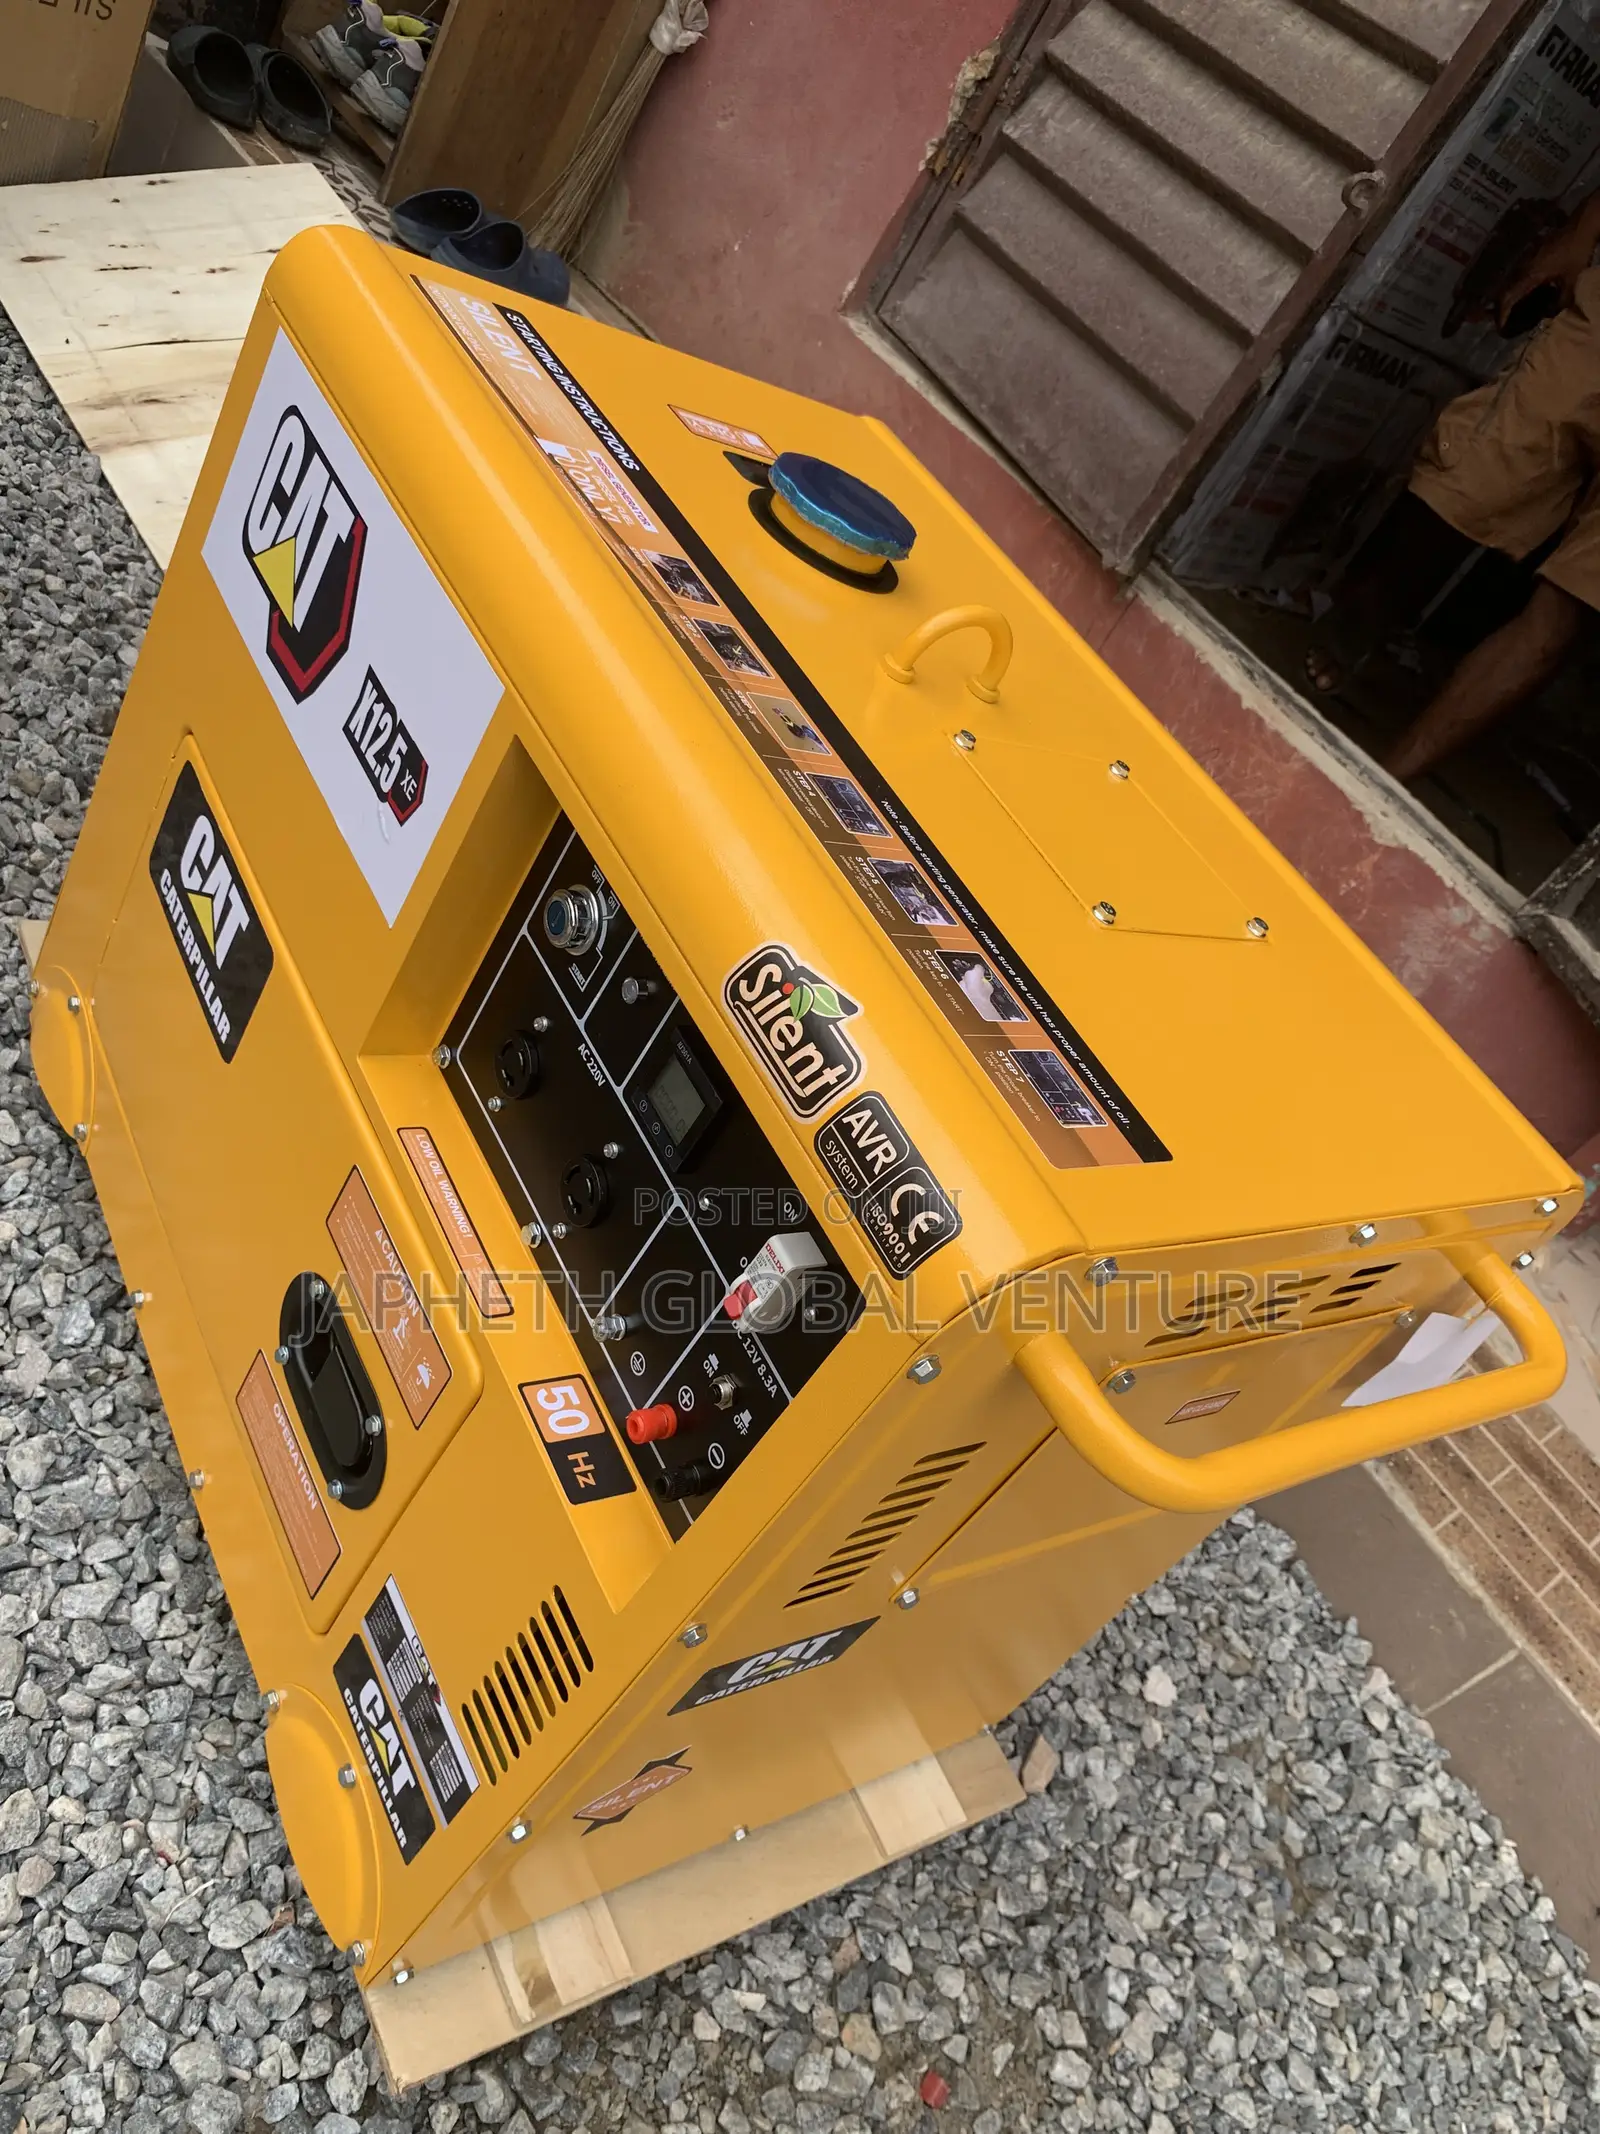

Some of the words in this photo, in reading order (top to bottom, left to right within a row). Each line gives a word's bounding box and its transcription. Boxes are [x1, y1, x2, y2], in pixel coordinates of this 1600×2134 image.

[454, 293, 544, 381] SILENT
[506, 313, 563, 374] STARTING
[554, 373, 639, 470] INSTRUCTIONS
[564, 467, 622, 523] ONLY!
[610, 480, 652, 527] GENERATOR
[246, 412, 357, 634] CAT
[677, 614, 697, 631] STEP
[732, 689, 753, 709] STEP
[400, 769, 417, 801] XE
[793, 770, 811, 789] STEP
[591, 869, 601, 885] OFF
[855, 856, 875, 877] STEP
[180, 815, 250, 970] CAT
[608, 895, 617, 910] ON
[160, 868, 231, 1043] CATERPILLAR
[571, 962, 586, 986] START
[881, 801, 898, 819] Note
[899, 825, 922, 851] Before
[920, 853, 946, 883] starting
[979, 931, 1000, 954] make
[998, 956, 1016, 975] sure
[1014, 977, 1027, 991] the
[1026, 993, 1043, 1009] unit
[1040, 1011, 1055, 1027] has
[1052, 1030, 1081, 1060] proper
[1079, 1063, 1110, 1098] amount
[1107, 1100, 1120, 1110] of
[923, 949, 944, 972] STEP
[738, 963, 848, 1098] Silent
[996, 1050, 1018, 1075] STEP
[825, 1139, 858, 1189] system
[842, 1108, 898, 1176] AVR
[415, 1133, 435, 1158] LOW
[427, 1160, 445, 1178] OIL
[436, 1179, 473, 1238] WARNING!
[784, 1201, 798, 1224] ON
[870, 1202, 911, 1263] ISO9001
[765, 1243, 785, 1274] DELIXI
[866, 1212, 902, 1268] CERTIFIED
[380, 1235, 419, 1318] CAUTION
[703, 1360, 714, 1378] ON
[742, 1337, 762, 1364] 12V
[757, 1364, 778, 1398] 8.3A
[536, 1385, 590, 1435] 50
[733, 1414, 748, 1435] OFF
[271, 1399, 318, 1512] OPERATION
[567, 1451, 597, 1488] Hz
[695, 1655, 834, 1705] CATERPILLAR
[726, 1630, 844, 1684] CAT
[359, 1678, 416, 1797] CAT
[344, 1688, 407, 1848] CATERPILLAR
[590, 1771, 682, 1811] SILENT
